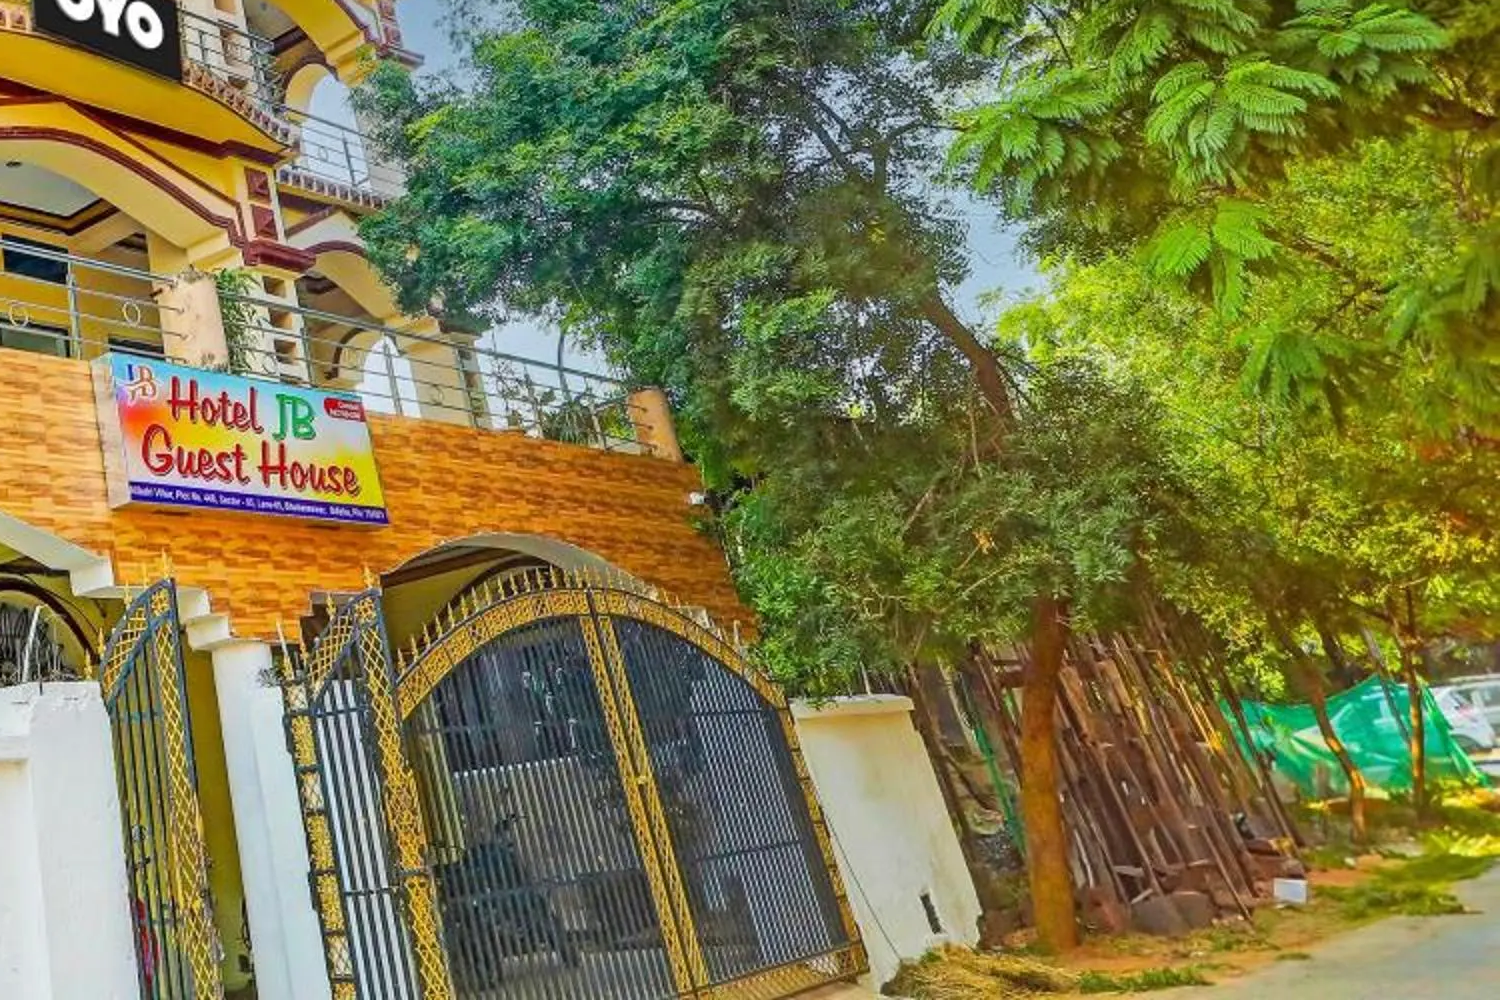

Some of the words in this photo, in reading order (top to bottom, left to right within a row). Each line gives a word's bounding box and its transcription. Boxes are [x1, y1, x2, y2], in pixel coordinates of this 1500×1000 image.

[167, 376, 264, 435] Hotel
[272, 393, 317, 441] JB
[141, 423, 251, 487] Guest
[257, 440, 363, 496] House
